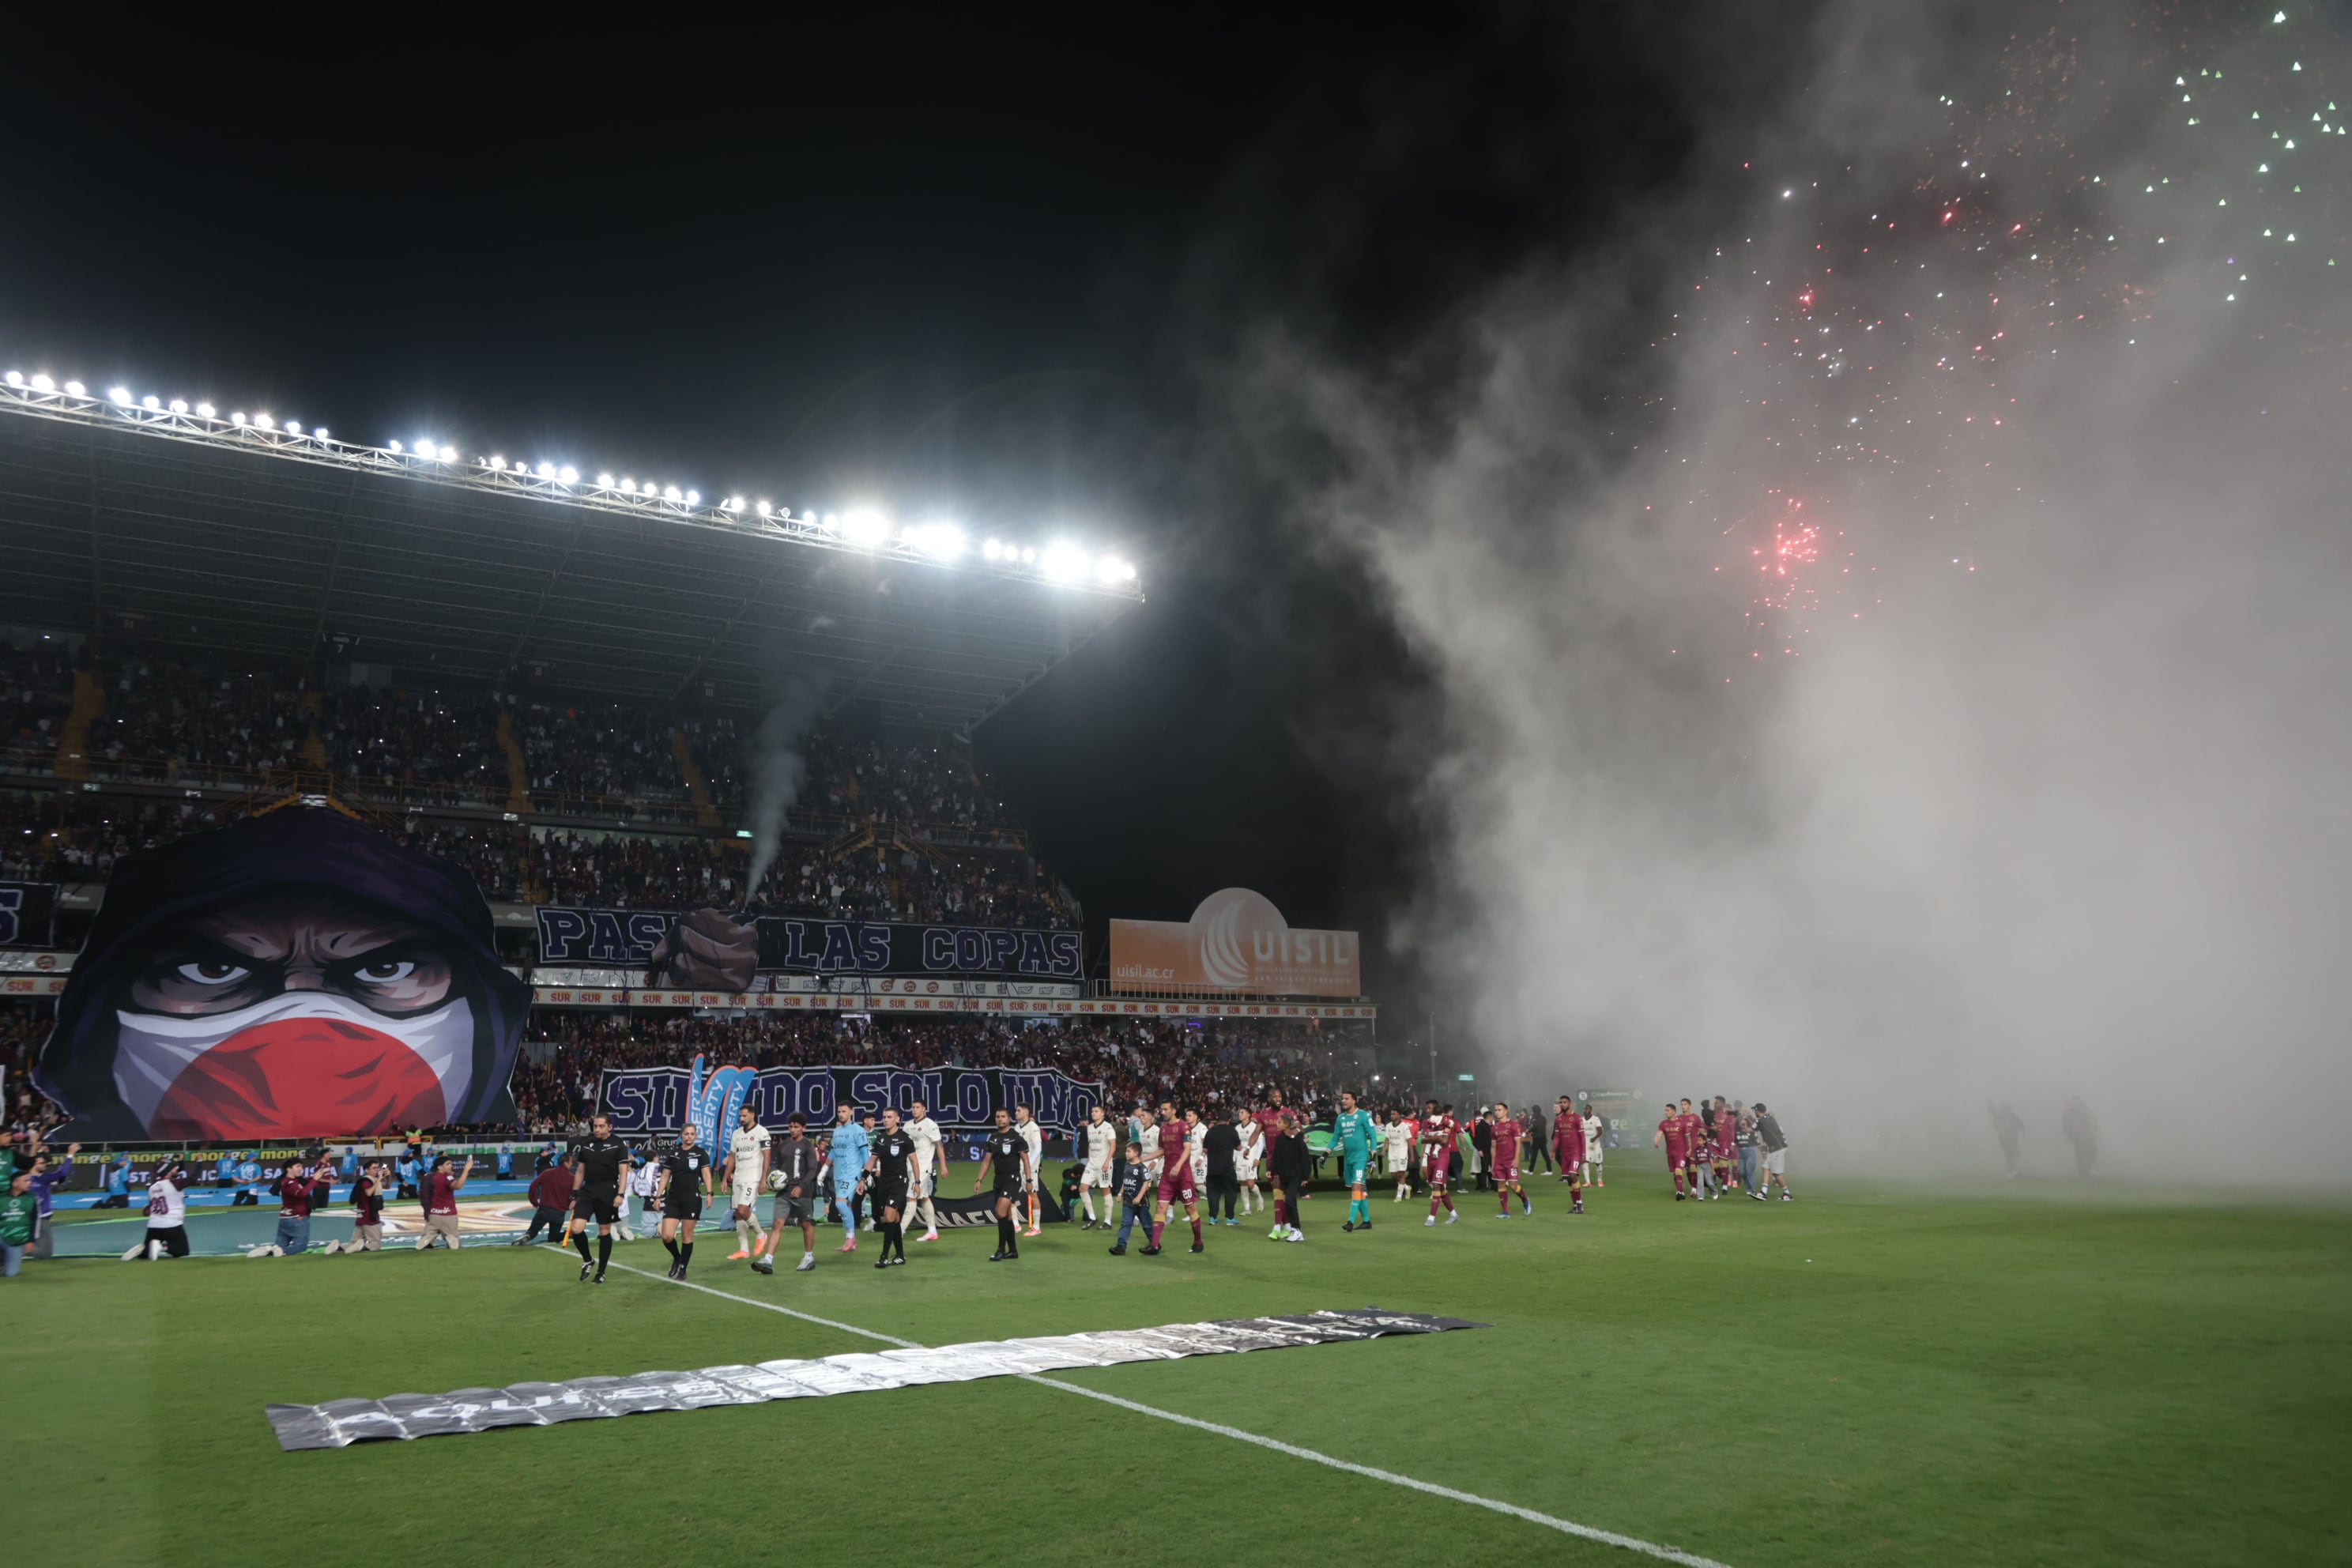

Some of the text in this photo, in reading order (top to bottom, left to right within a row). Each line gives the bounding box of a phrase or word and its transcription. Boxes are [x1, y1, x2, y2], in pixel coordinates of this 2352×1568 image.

[541, 910, 1080, 975] PAS LAS COPAS
[1253, 930, 1349, 963] UISIL
[1117, 964, 1175, 980] uisil.ac.cr
[8, 982, 64, 993] SUR SU
[551, 993, 571, 1002] SUR
[582, 993, 601, 1003] SUR
[612, 994, 631, 1003] SUR
[643, 995, 662, 1004] SUR
[672, 995, 691, 1004] SUR
[700, 996, 718, 1005] SUR
[729, 997, 746, 1005] SUR
[756, 997, 774, 1006] SUR
[784, 998, 801, 1007] SUR
[837, 999, 853, 1008] SUR
[890, 1000, 905, 1008] SUR
[1033, 1003, 1048, 1012] SUR
[1080, 1004, 1095, 1012] SUR
[1102, 1004, 1116, 1012] SUR
[1186, 1005, 1200, 1014] SUR
[1286, 1007, 1298, 1016] SUR
[851, 1071, 989, 1124] SOLO
[1000, 1073, 1099, 1129] UNO
[692, 1071, 705, 1148] IBERTY
[49, 1153, 111, 1165] mnge
[190, 1150, 251, 1161] moge
[260, 1149, 307, 1160] mong
[1182, 1189, 1193, 1200] 20
